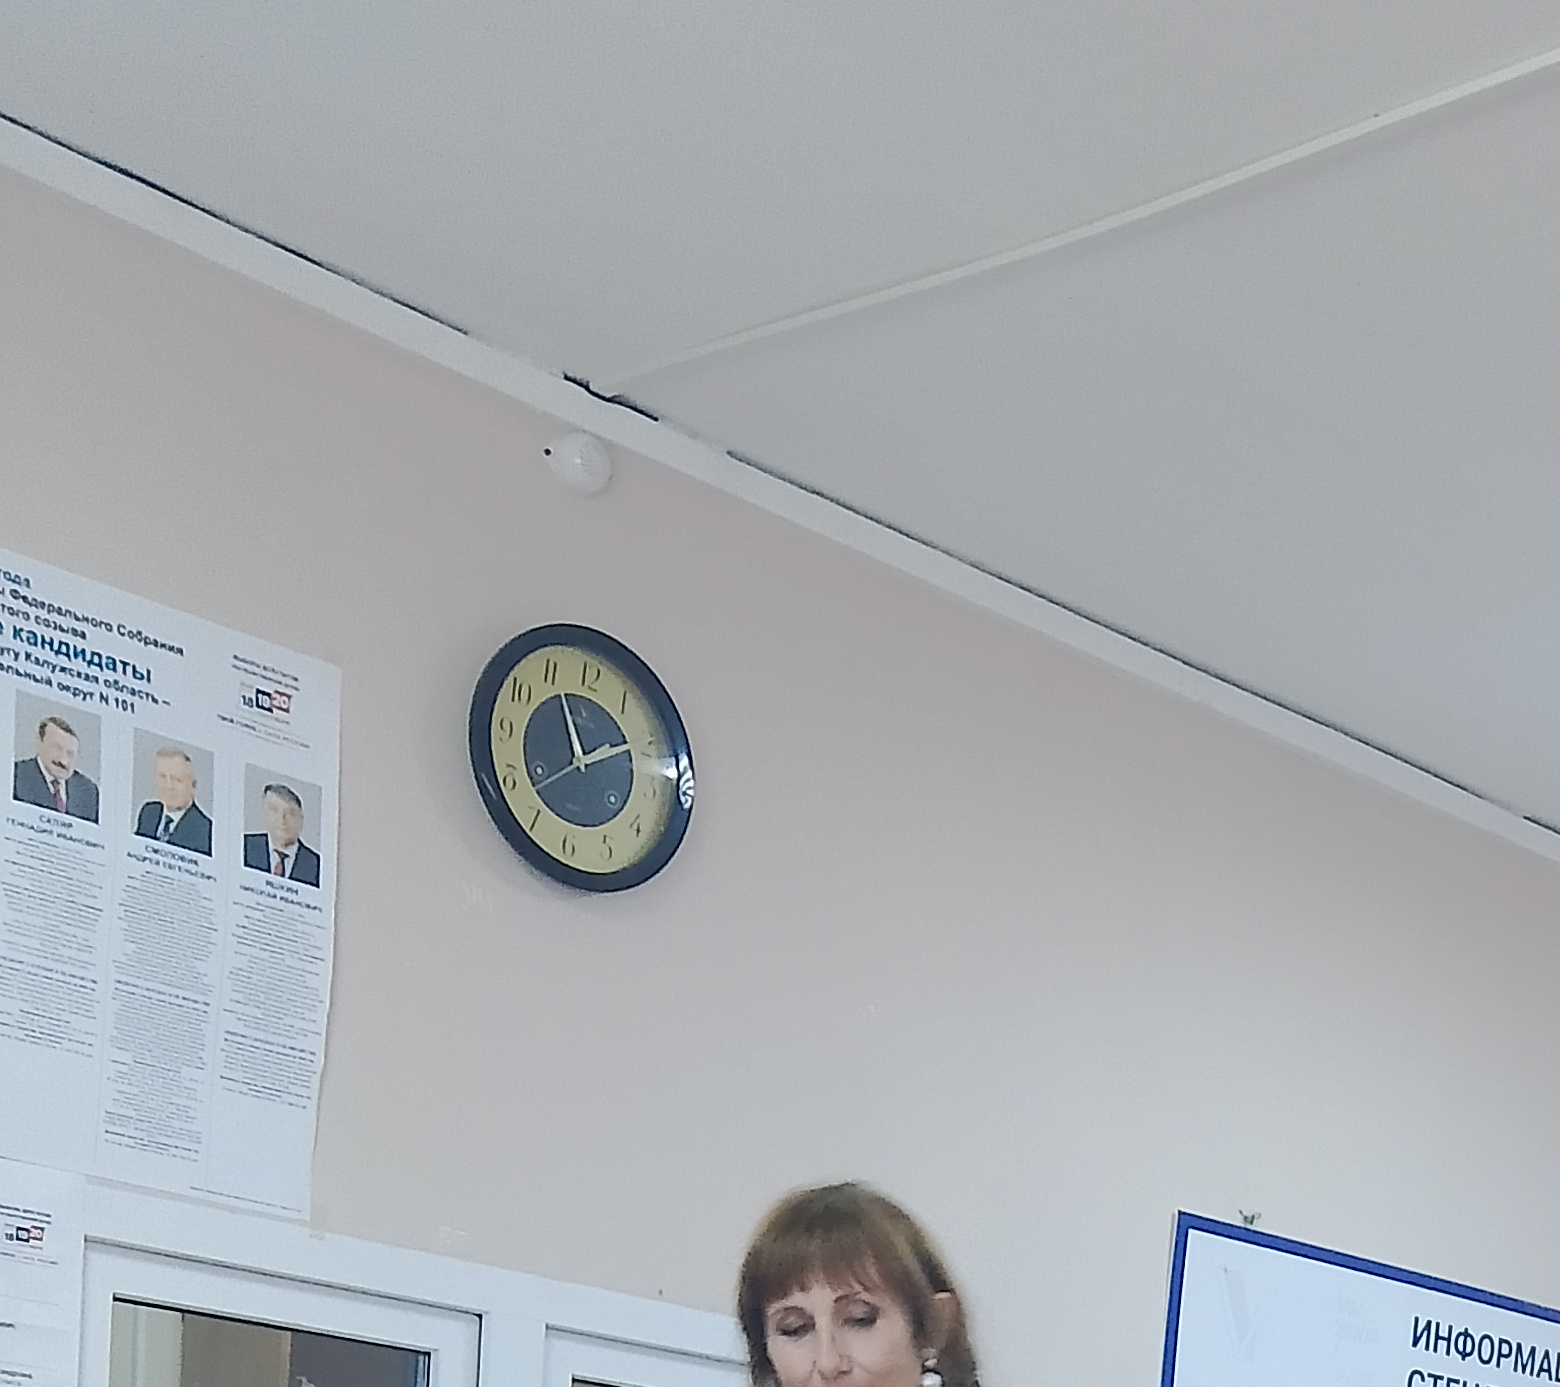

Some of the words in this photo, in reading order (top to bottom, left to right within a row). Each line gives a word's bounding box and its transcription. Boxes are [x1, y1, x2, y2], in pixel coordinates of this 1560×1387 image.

[9, 588, 113, 633] Федерального
[117, 623, 184, 657] Собрания
[34, 615, 87, 640] созыва
[12, 624, 151, 684] кандидаты
[25, 651, 99, 685] Калужская
[104, 679, 159, 705] область
[544, 658, 557, 686] 11
[581, 661, 600, 692] 12
[57, 682, 95, 701] округ
[99, 691, 109, 706] N
[114, 697, 135, 714] 101
[511, 677, 532, 705] 10
[621, 690, 627, 715] 1
[499, 717, 513, 743] 9
[502, 762, 517, 792] 8
[528, 805, 541, 832] 7
[629, 813, 641, 838] 4
[561, 832, 576, 858] 6
[600, 834, 613, 861] 5
